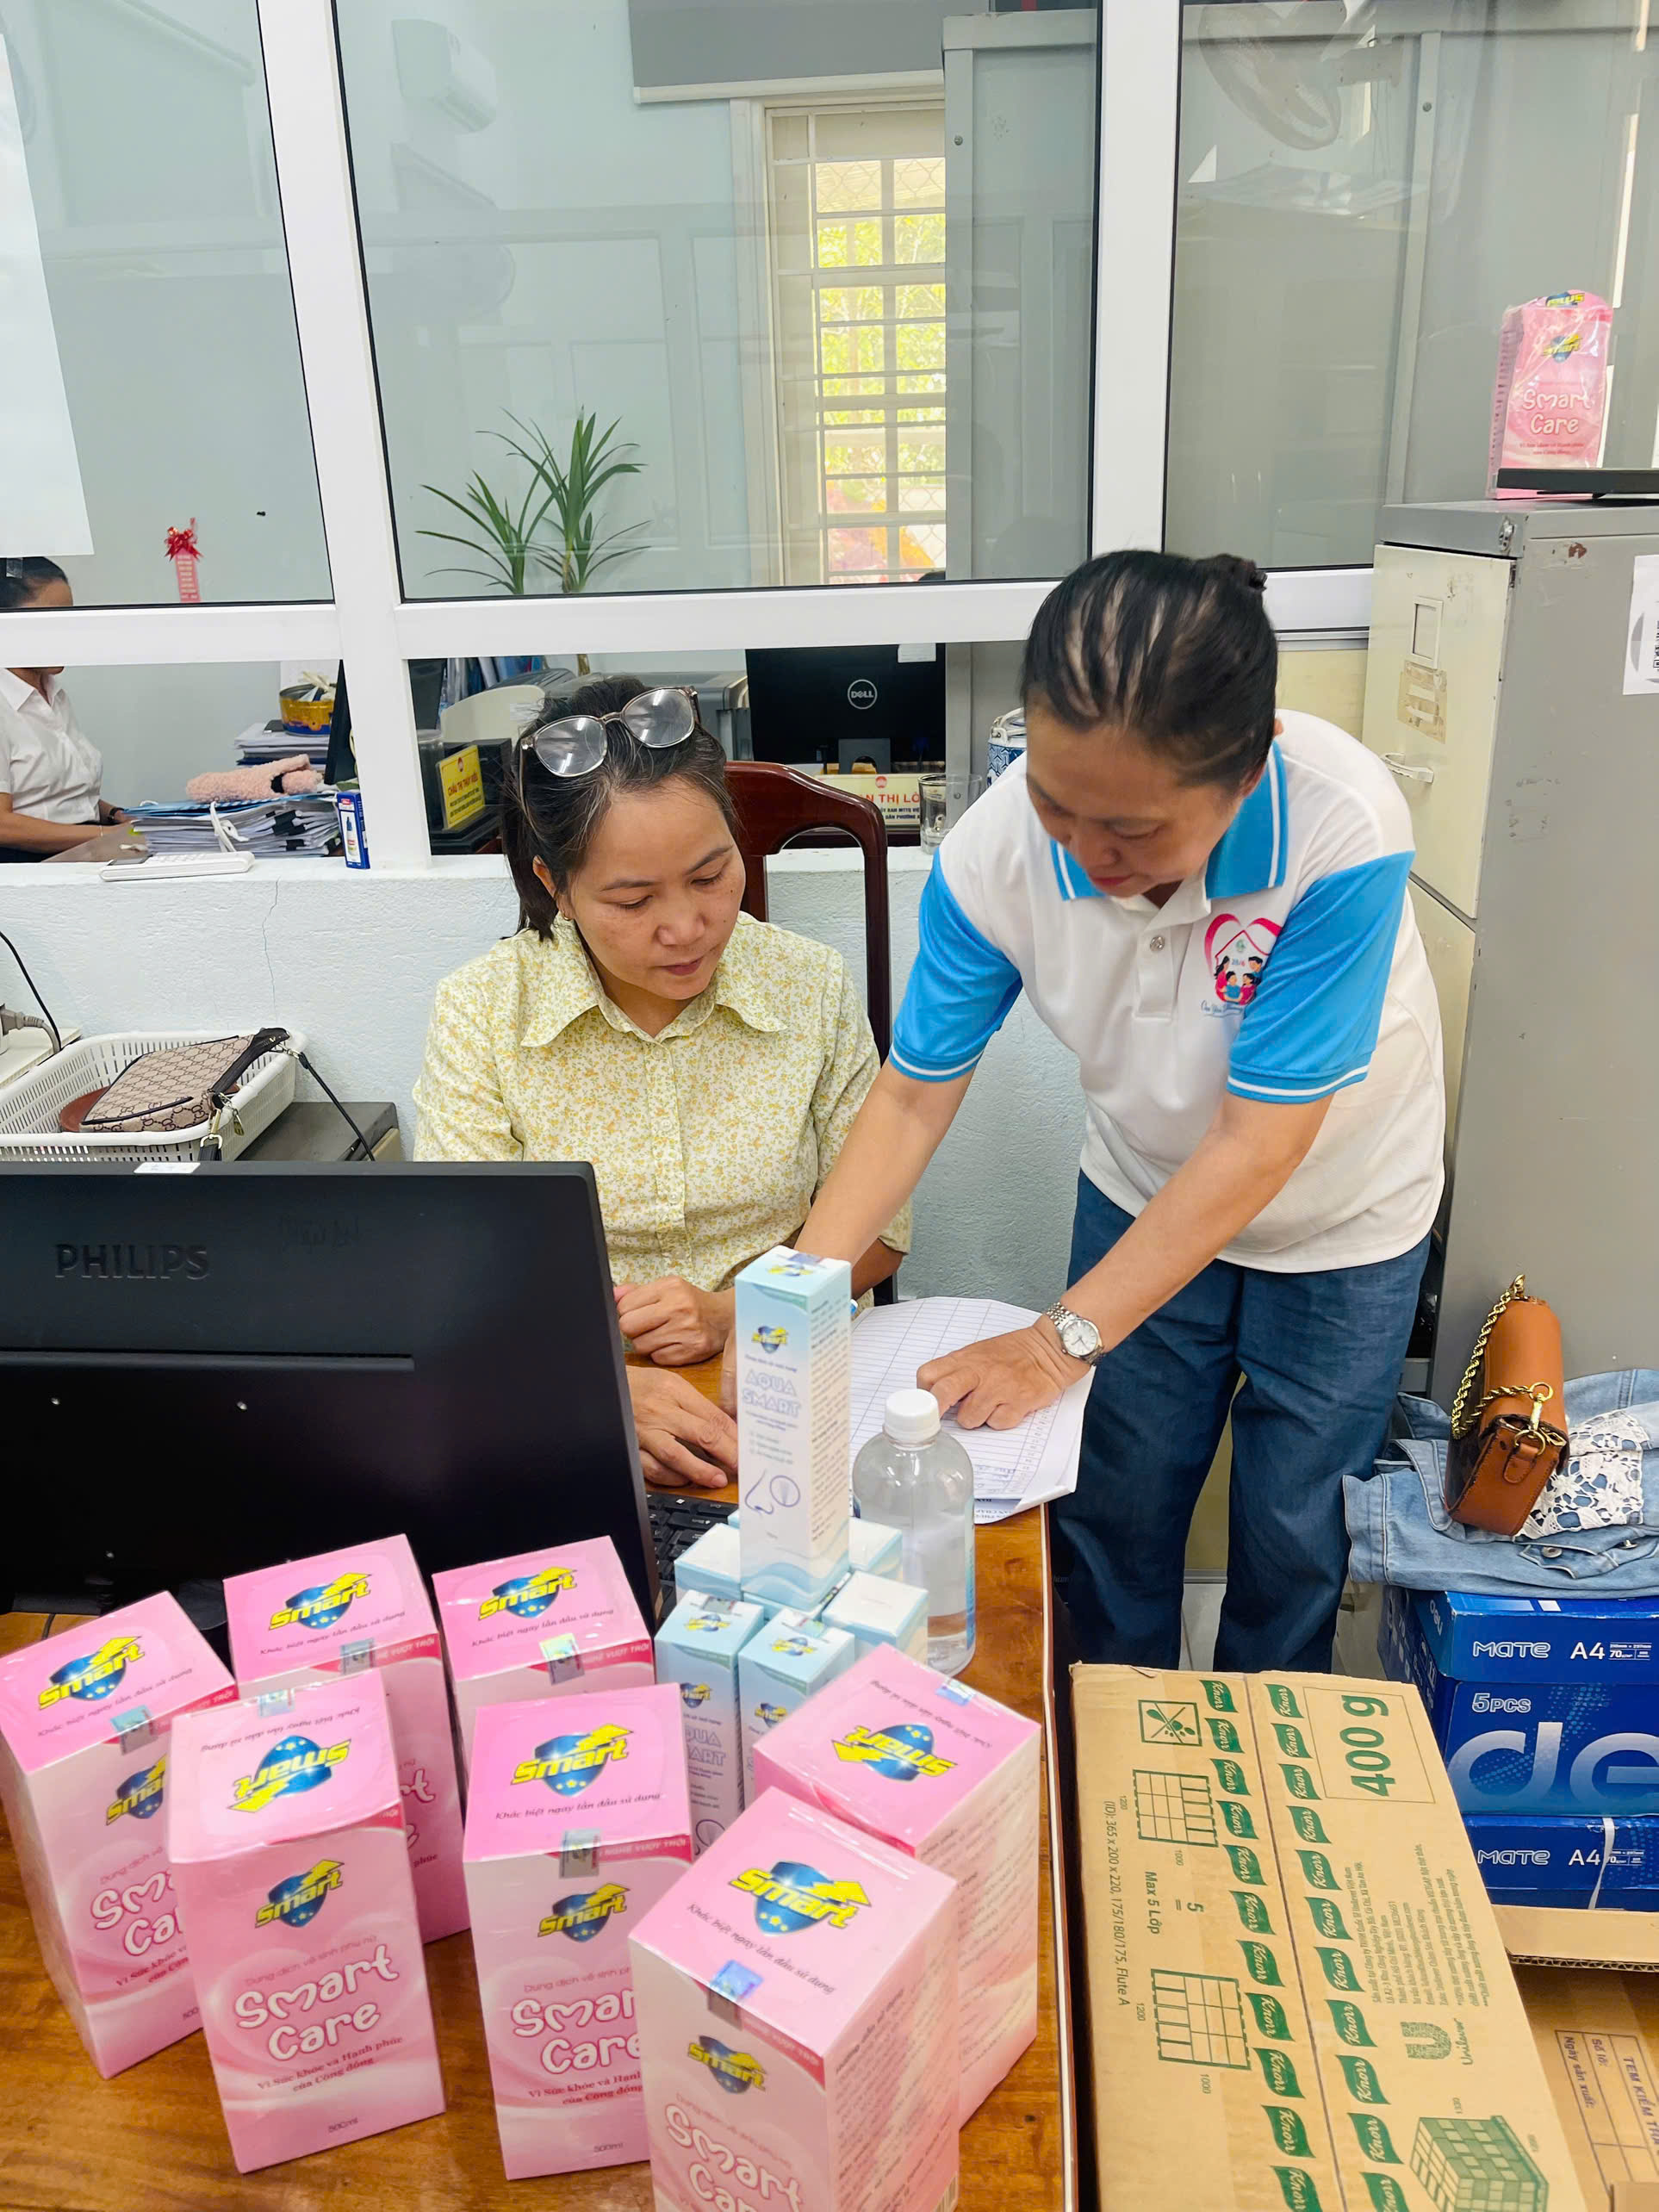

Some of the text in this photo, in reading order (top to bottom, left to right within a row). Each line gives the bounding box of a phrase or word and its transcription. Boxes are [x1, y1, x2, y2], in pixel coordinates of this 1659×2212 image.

[1522, 388, 1594, 412] Smart
[1530, 413, 1580, 434] Care
[851, 690, 873, 699] DELL
[54, 1243, 210, 1280] PHILIPS
[744, 1369, 798, 1397] AQUA
[743, 1388, 802, 1418] SMART
[1569, 1642, 1605, 1660] A4
[1212, 1682, 1224, 1709] Knorr
[1279, 1687, 1292, 1716] Knorr
[1217, 1721, 1230, 1750] Knorr
[1286, 1726, 1300, 1756] Knorr
[1341, 1694, 1395, 1798] 400 g
[1224, 1762, 1237, 1791] Knorr
[1295, 1767, 1308, 1799] Knorr
[1106, 1819, 1118, 1838] 365
[1230, 1805, 1243, 1835] Knorr
[1303, 1810, 1316, 1842] Knorr
[1108, 1847, 1119, 1865] 200
[1239, 1849, 1250, 1880] Knorr
[1314, 1854, 1327, 1888] Knorr
[1569, 1849, 1600, 1865] A4
[1109, 1873, 1121, 1895] 220,
[1145, 1871, 1158, 1896] Max
[1188, 1902, 1204, 1912] 5
[1246, 1894, 1258, 1930] Knorr
[1323, 1902, 1338, 1938] Knorr
[1110, 1897, 1128, 1965] 175/180/175,
[1252, 1944, 1267, 1981] Knorr
[1334, 1950, 1350, 1990] Knorr
[235, 1944, 400, 2029] Smart
[1116, 1967, 1130, 1995] Flute
[511, 1987, 635, 2037] Smar
[1119, 1998, 1131, 2006] A
[1261, 1997, 1276, 2036] Knorr
[268, 2003, 382, 2060] Care
[1344, 2003, 1361, 2045] Knorr
[1453, 2018, 1474, 2065] Unilever
[1564, 2036, 1579, 2061] Ngày
[1270, 2052, 1286, 2093] Knorr
[1357, 2060, 1374, 2102] Knorr
[1623, 2057, 1641, 2083] TEM
[1279, 2109, 1296, 2153] Knorr
[1368, 2116, 1386, 2160] Knorr
[1289, 2168, 1307, 2209] Knorr
